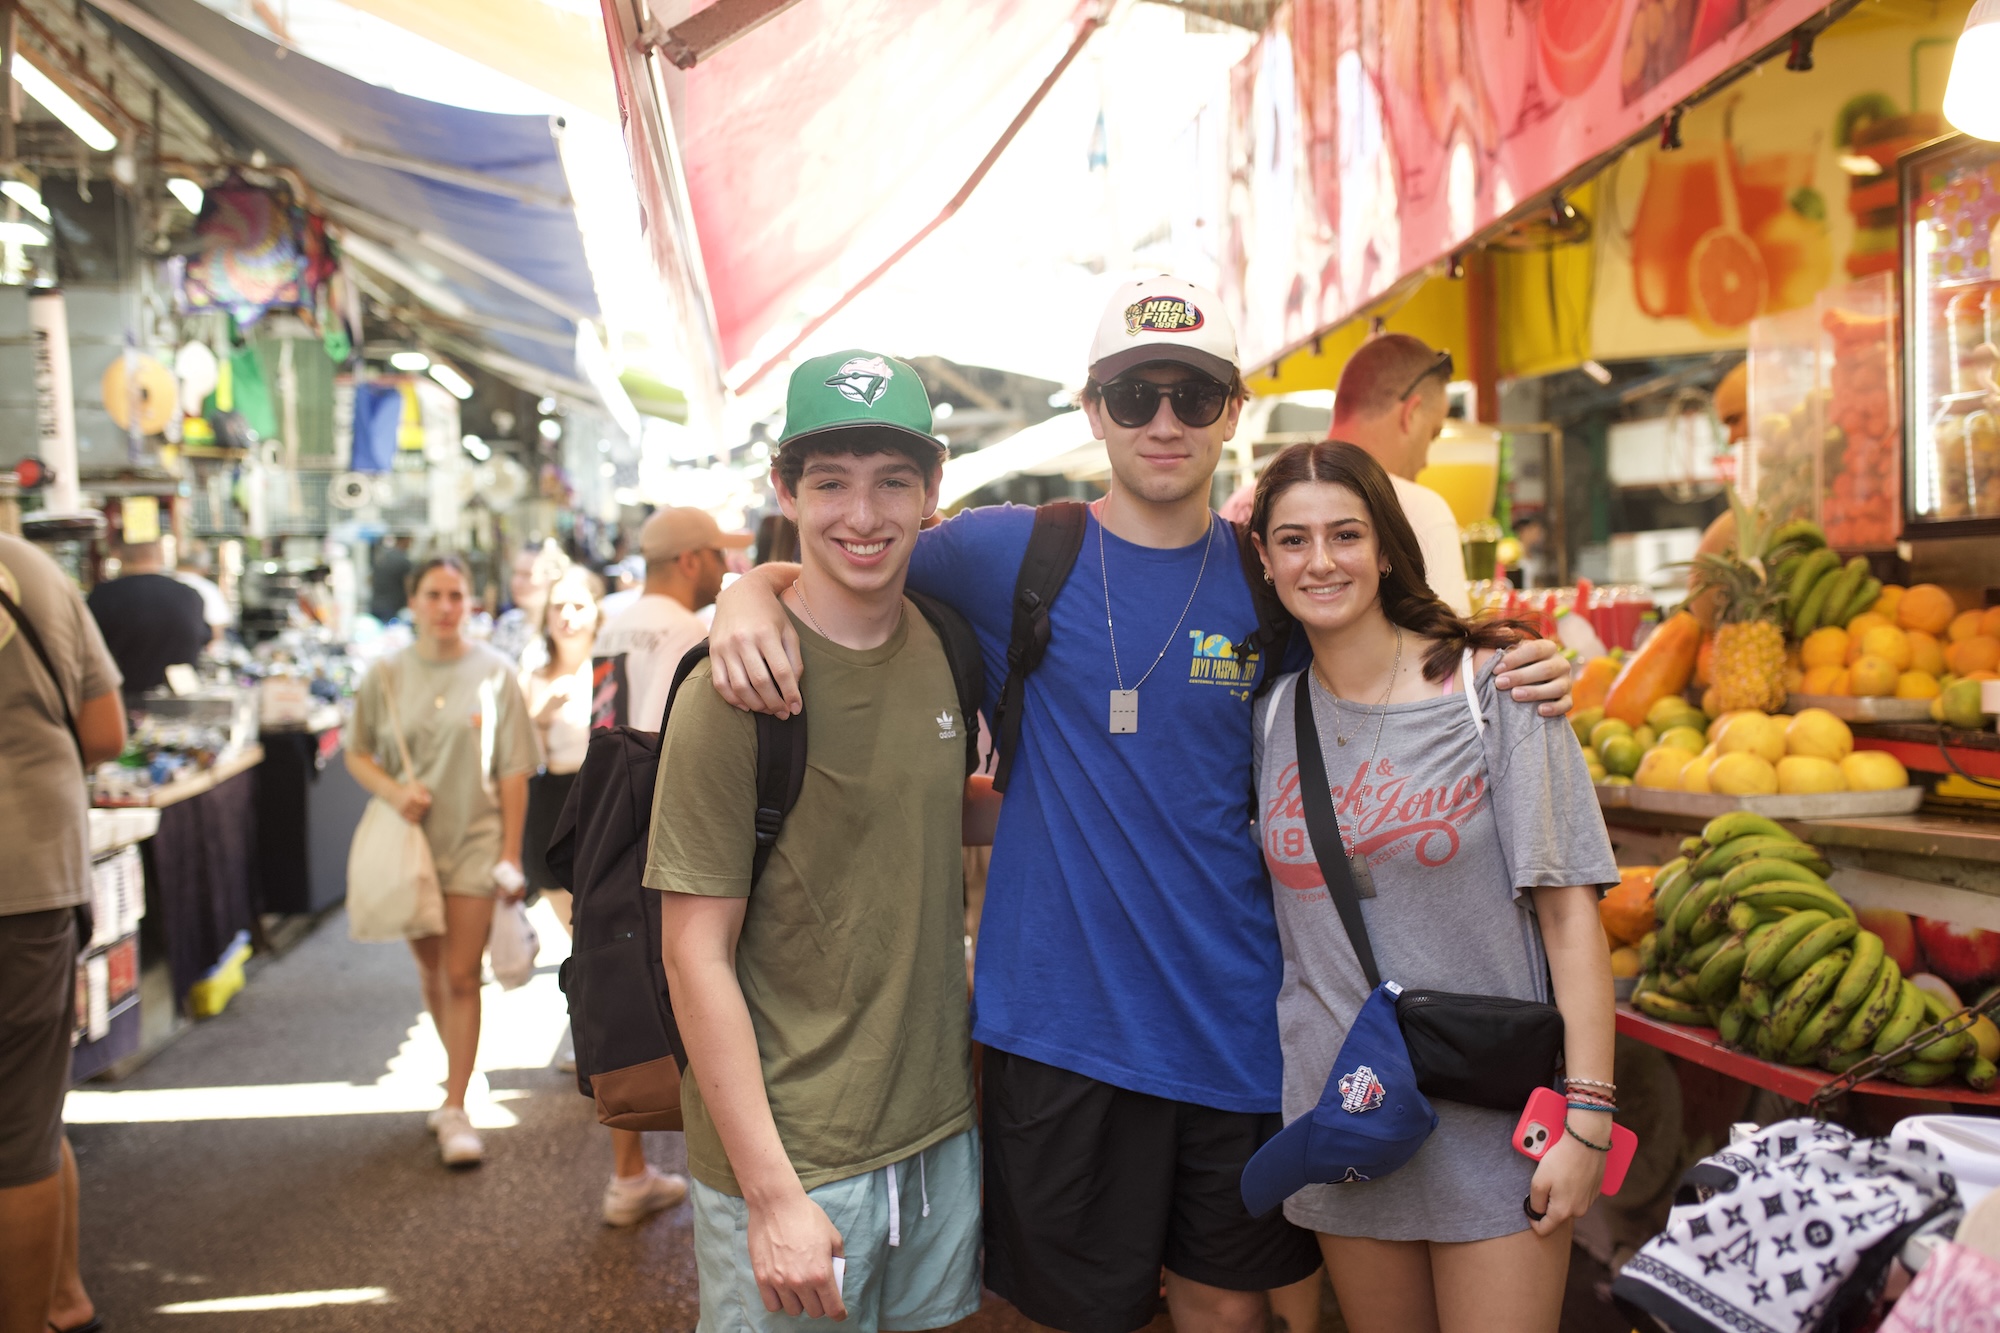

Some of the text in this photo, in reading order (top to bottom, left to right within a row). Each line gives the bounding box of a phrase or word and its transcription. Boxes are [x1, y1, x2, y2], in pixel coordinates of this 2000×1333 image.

[1140, 312, 1197, 326] Finals
[1145, 300, 1184, 312] NBA
[1376, 758, 1395, 777] &
[1358, 769, 1485, 836] Jones
[1368, 840, 1412, 870] PRESENT
[1344, 1067, 1367, 1110] CHAMPIONS
[1354, 1073, 1371, 1107] DIVISION
